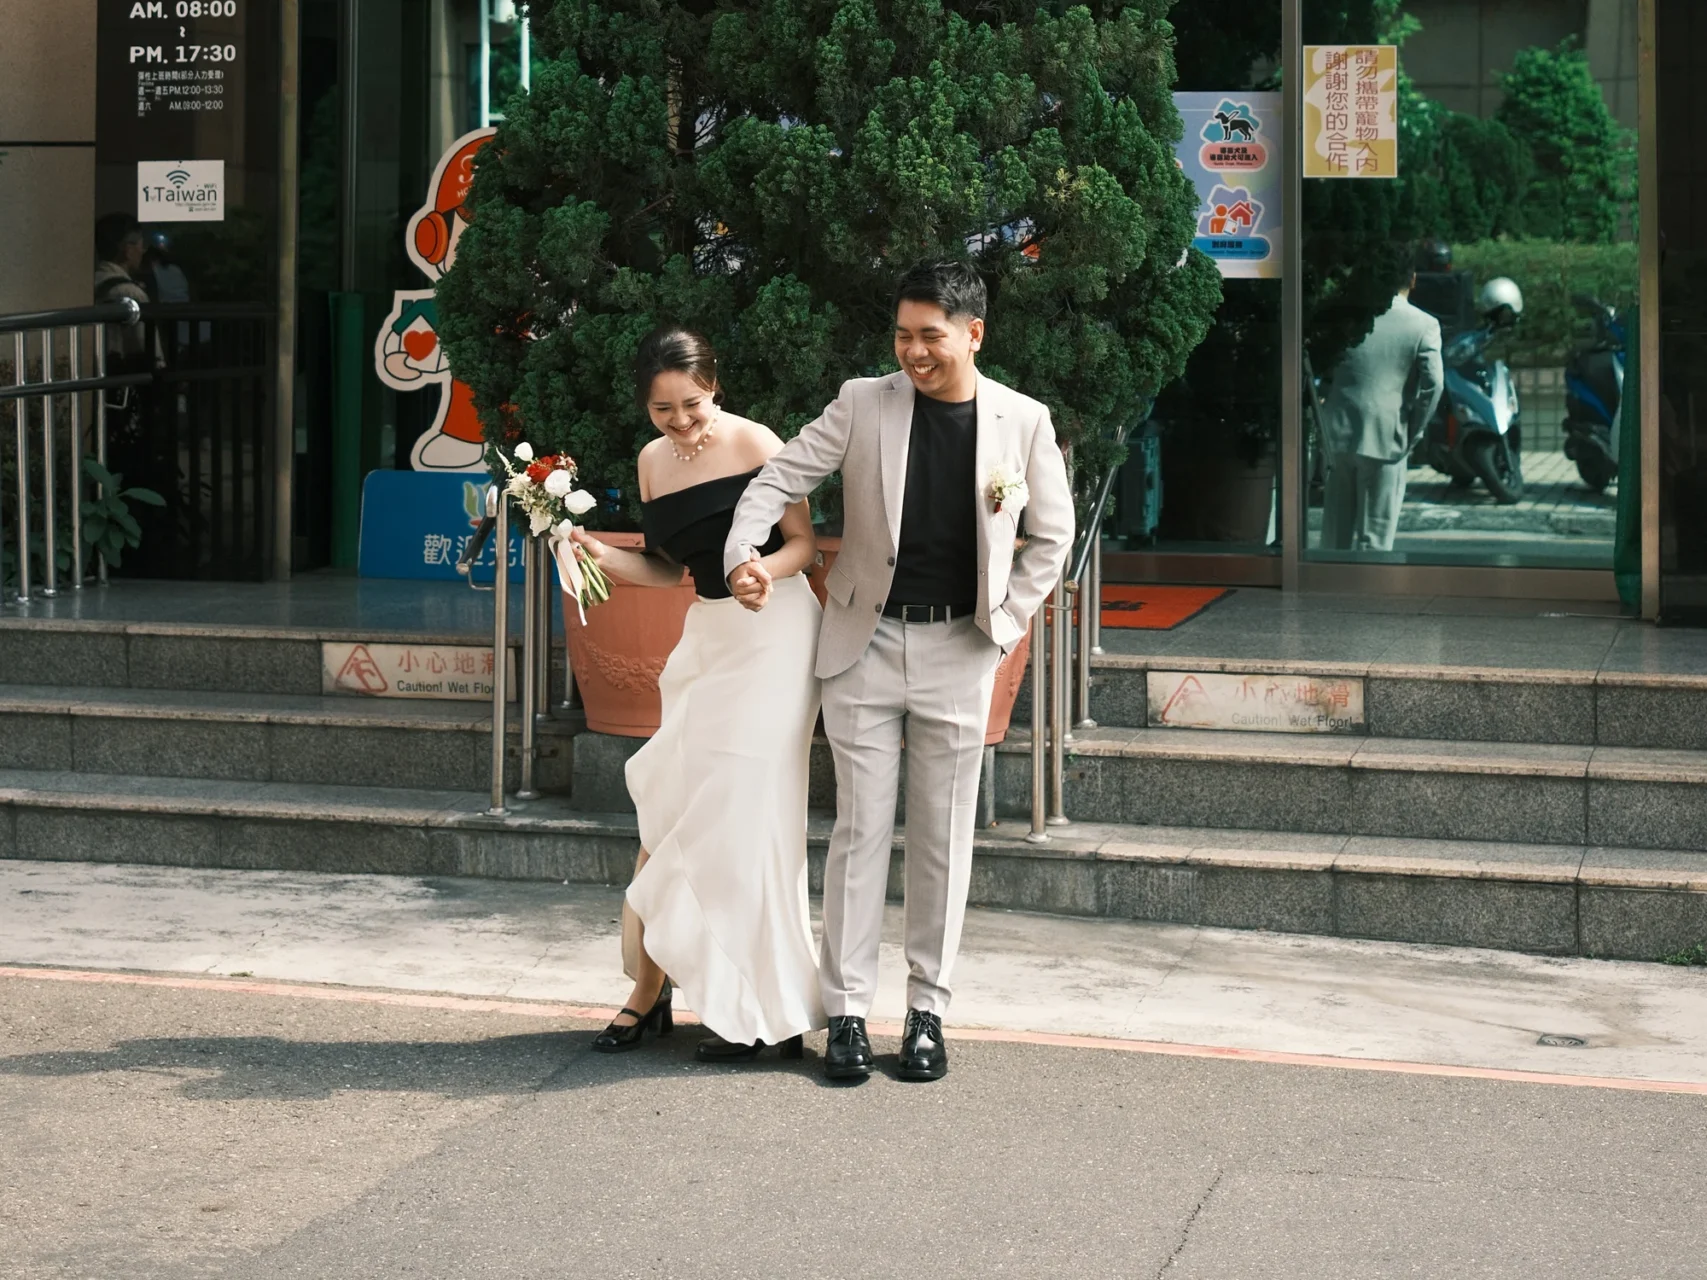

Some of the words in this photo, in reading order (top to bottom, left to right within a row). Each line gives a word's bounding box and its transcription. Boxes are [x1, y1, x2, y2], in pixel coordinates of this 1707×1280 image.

[130, 1, 168, 19] AM.
[175, 0, 236, 18] 08:00
[130, 45, 168, 64] PM.
[175, 44, 236, 63] 17:30
[1325, 51, 1348, 172] 謝謝您的合作
[397, 679, 443, 693] Caution!
[447, 682, 470, 694] Wet
[1289, 714, 1312, 727] Wet
